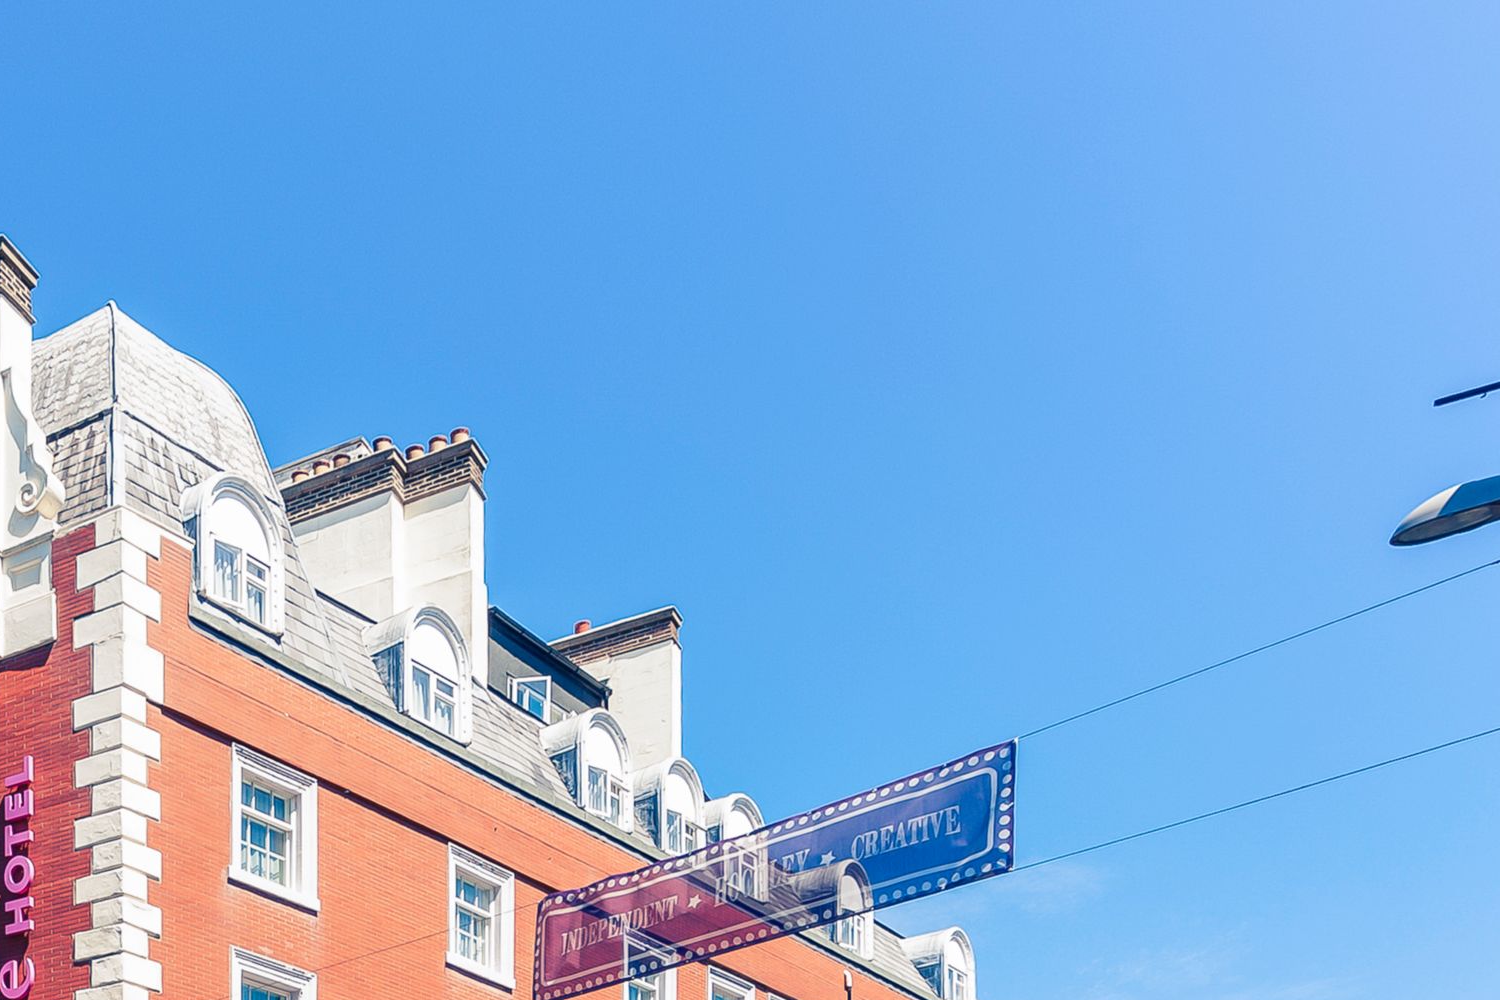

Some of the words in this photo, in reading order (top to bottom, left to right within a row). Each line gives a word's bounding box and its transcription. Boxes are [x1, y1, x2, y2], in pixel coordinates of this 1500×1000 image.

[4, 755, 35, 936] HOTEL
[561, 895, 679, 957] INDEPENDENT
[714, 848, 811, 908] HOCLEY
[851, 805, 962, 861] CREATIVE
